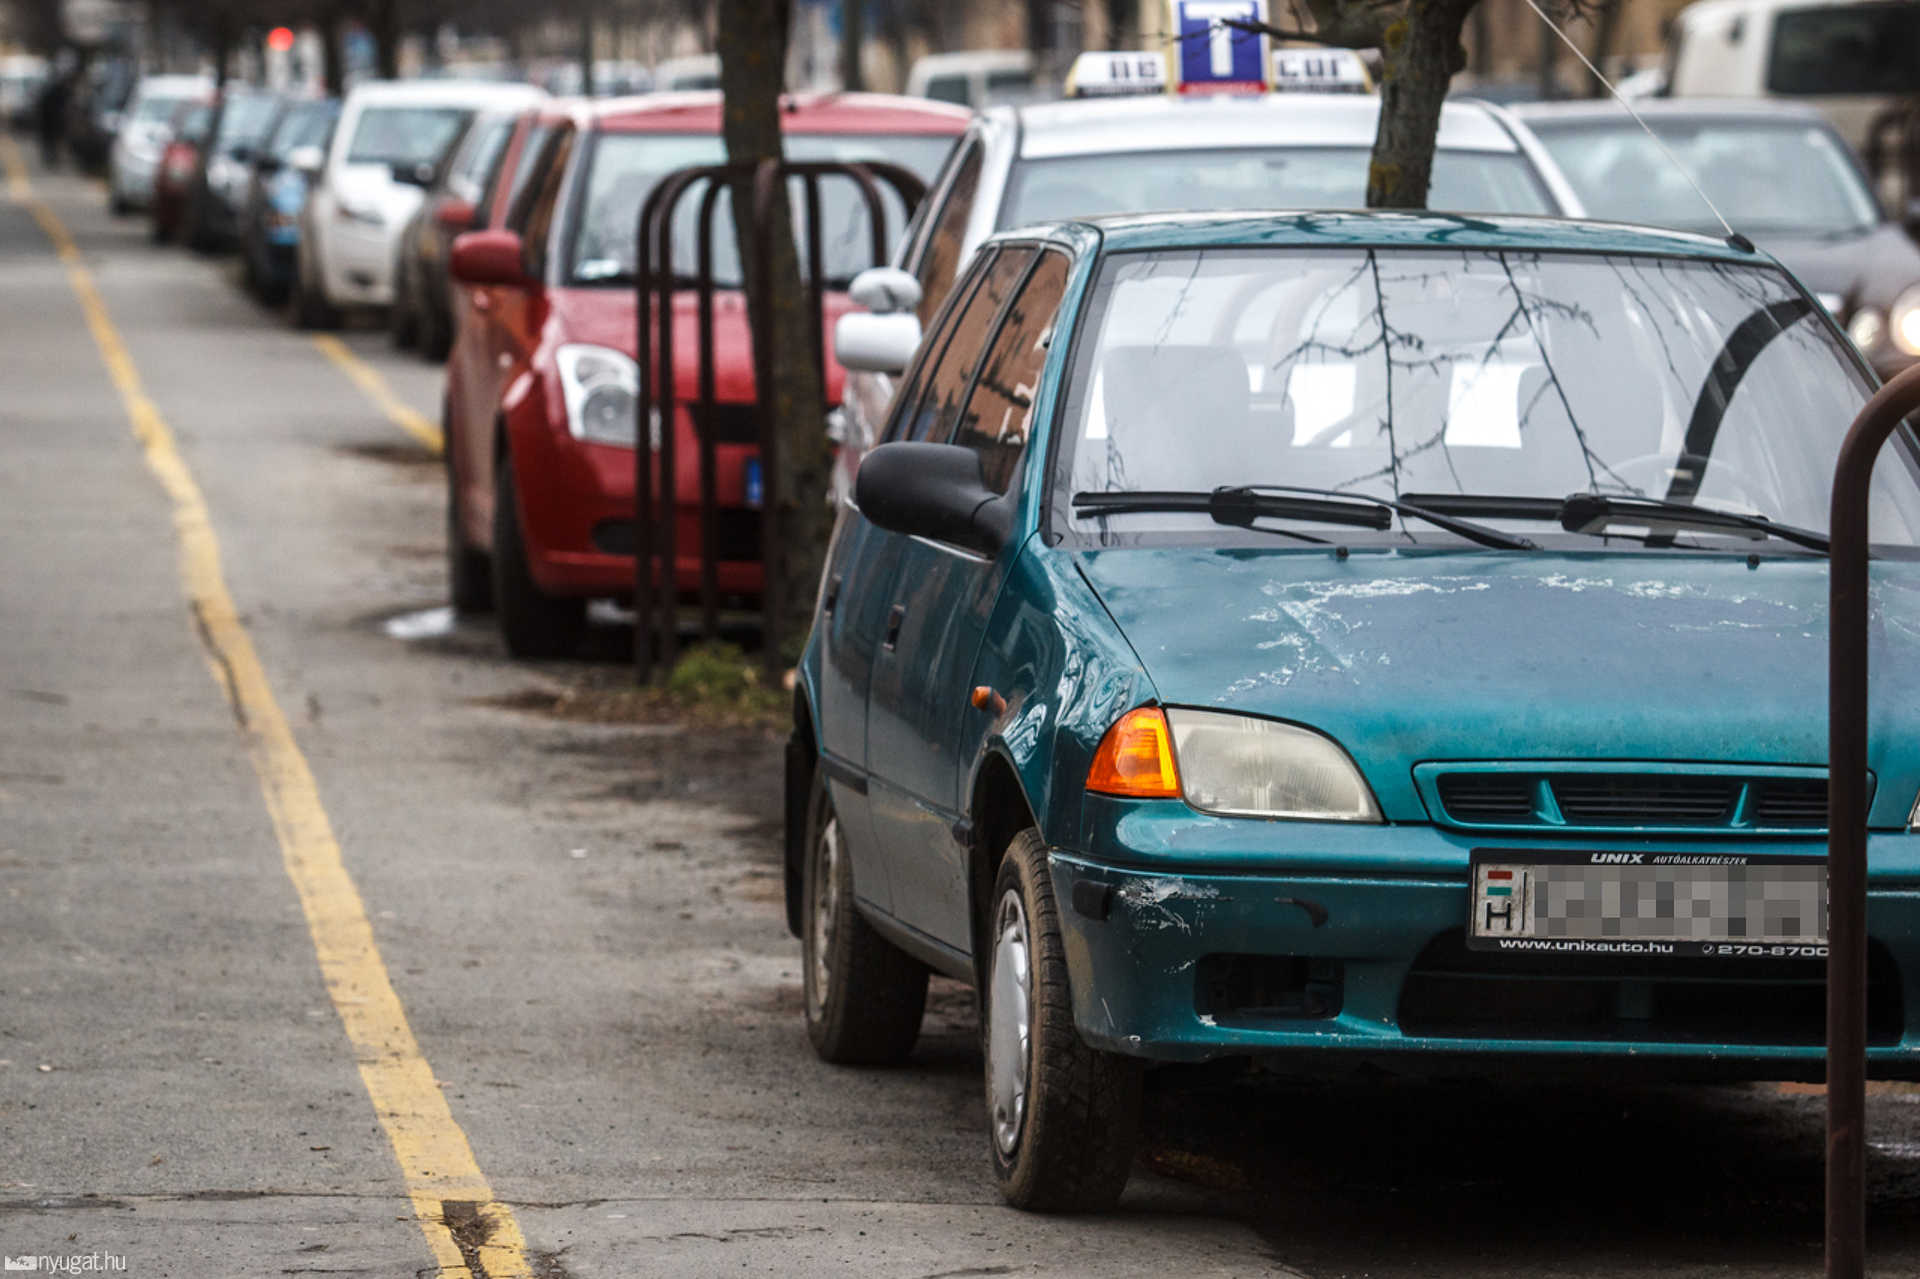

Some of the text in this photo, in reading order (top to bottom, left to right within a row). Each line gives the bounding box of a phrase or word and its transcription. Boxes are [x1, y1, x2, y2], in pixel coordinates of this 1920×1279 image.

[1590, 852, 1645, 864] UNIX
[1486, 902, 1512, 929] H
[1500, 939, 1673, 953] www.unixauto.hu
